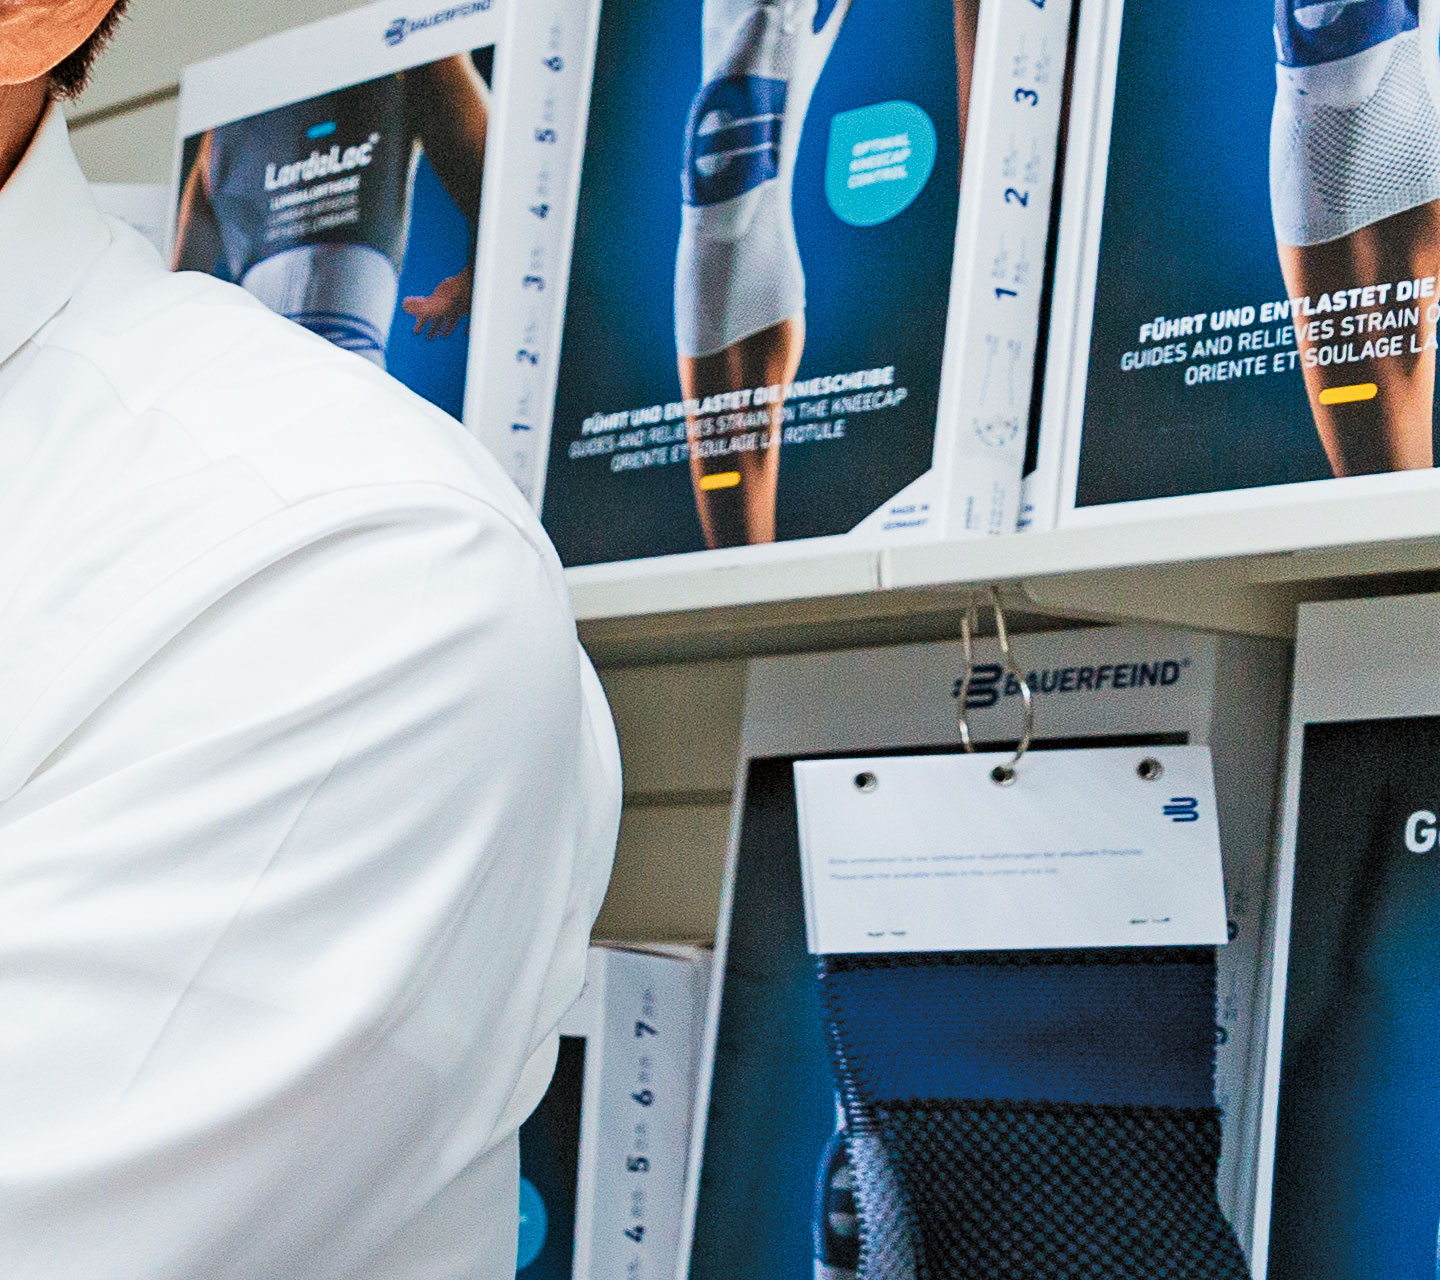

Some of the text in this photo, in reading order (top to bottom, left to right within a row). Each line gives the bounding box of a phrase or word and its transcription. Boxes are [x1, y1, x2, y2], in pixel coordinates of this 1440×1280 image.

[1014, 87, 1039, 106] 3
[1004, 186, 1029, 207] 2
[994, 286, 1018, 300] 1
[1138, 276, 1437, 344] FÜHRT UND ENTLASTET DIE
[1121, 341, 1188, 372] GUIDES
[1192, 334, 1232, 361] AND
[1237, 320, 1335, 354] RELIEVES
[1340, 306, 1419, 337] STRAIN
[1184, 354, 1268, 386] ORIENTE
[1272, 350, 1300, 373] ET
[1304, 333, 1404, 370] SOULAGE
